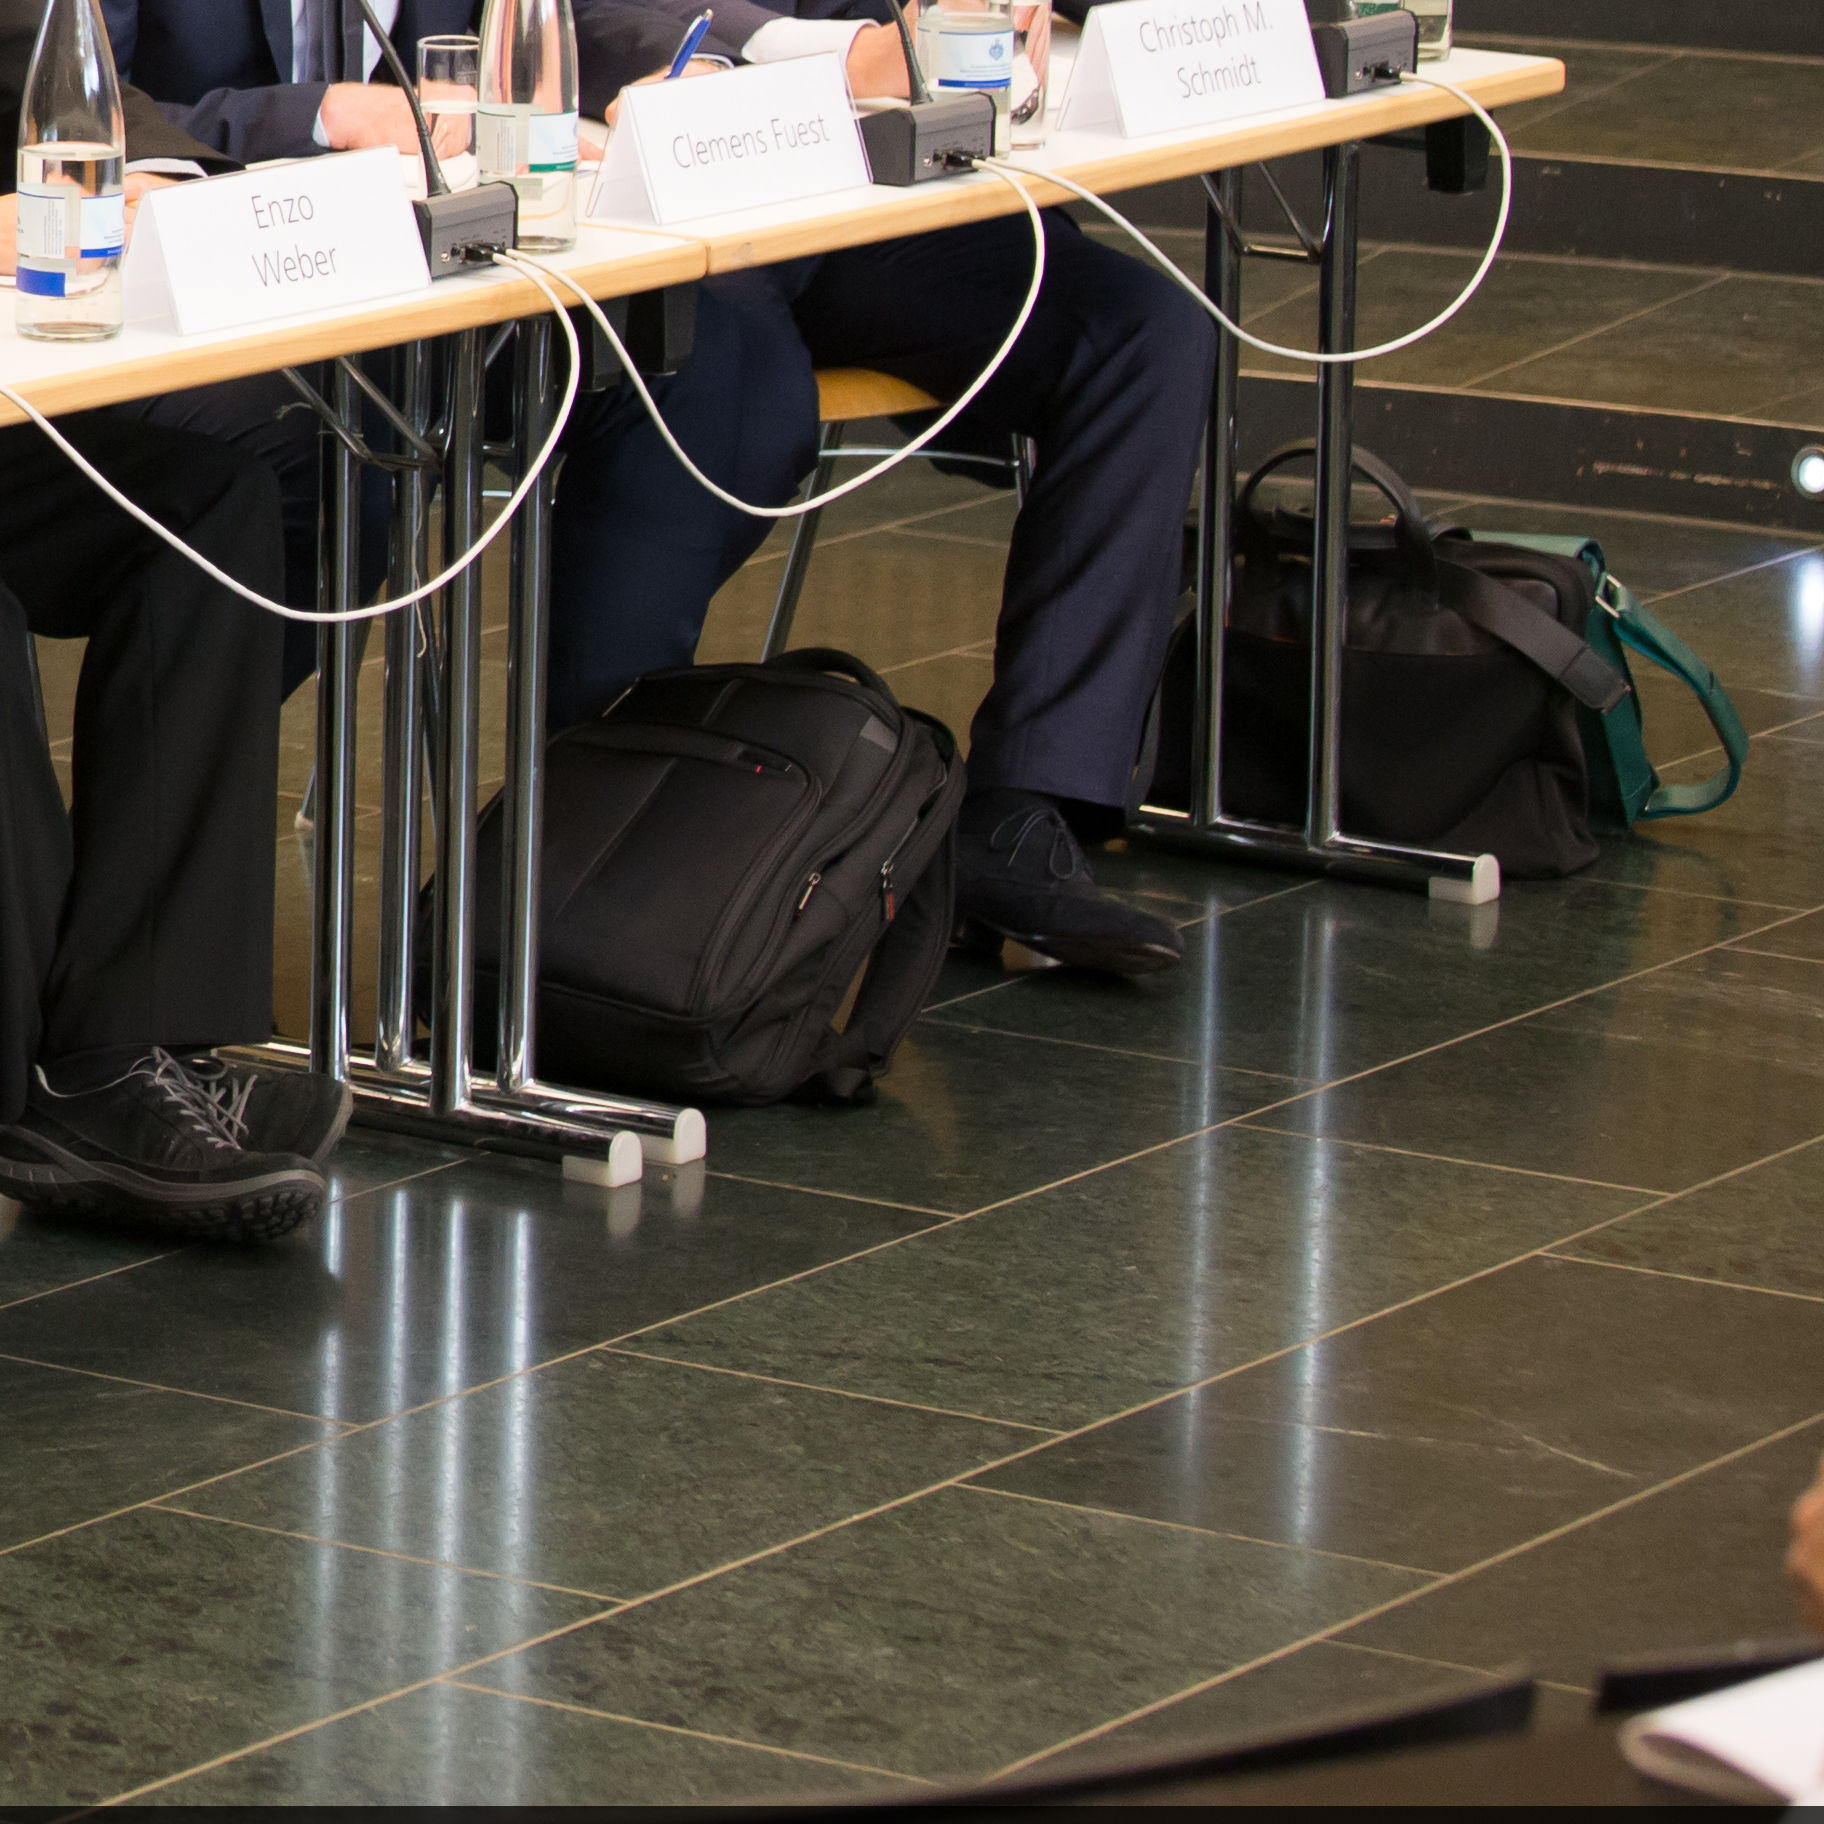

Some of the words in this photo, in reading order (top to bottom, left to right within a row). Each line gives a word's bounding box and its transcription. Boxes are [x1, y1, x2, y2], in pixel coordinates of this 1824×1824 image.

[1139, 7, 1239, 53] Christoph
[1242, 1, 1274, 32] M.
[1177, 54, 1261, 99] Schmidt
[673, 131, 768, 169] Clemens
[770, 115, 830, 149] Fuest
[251, 195, 314, 229] Enzo
[251, 245, 336, 287] Weber
